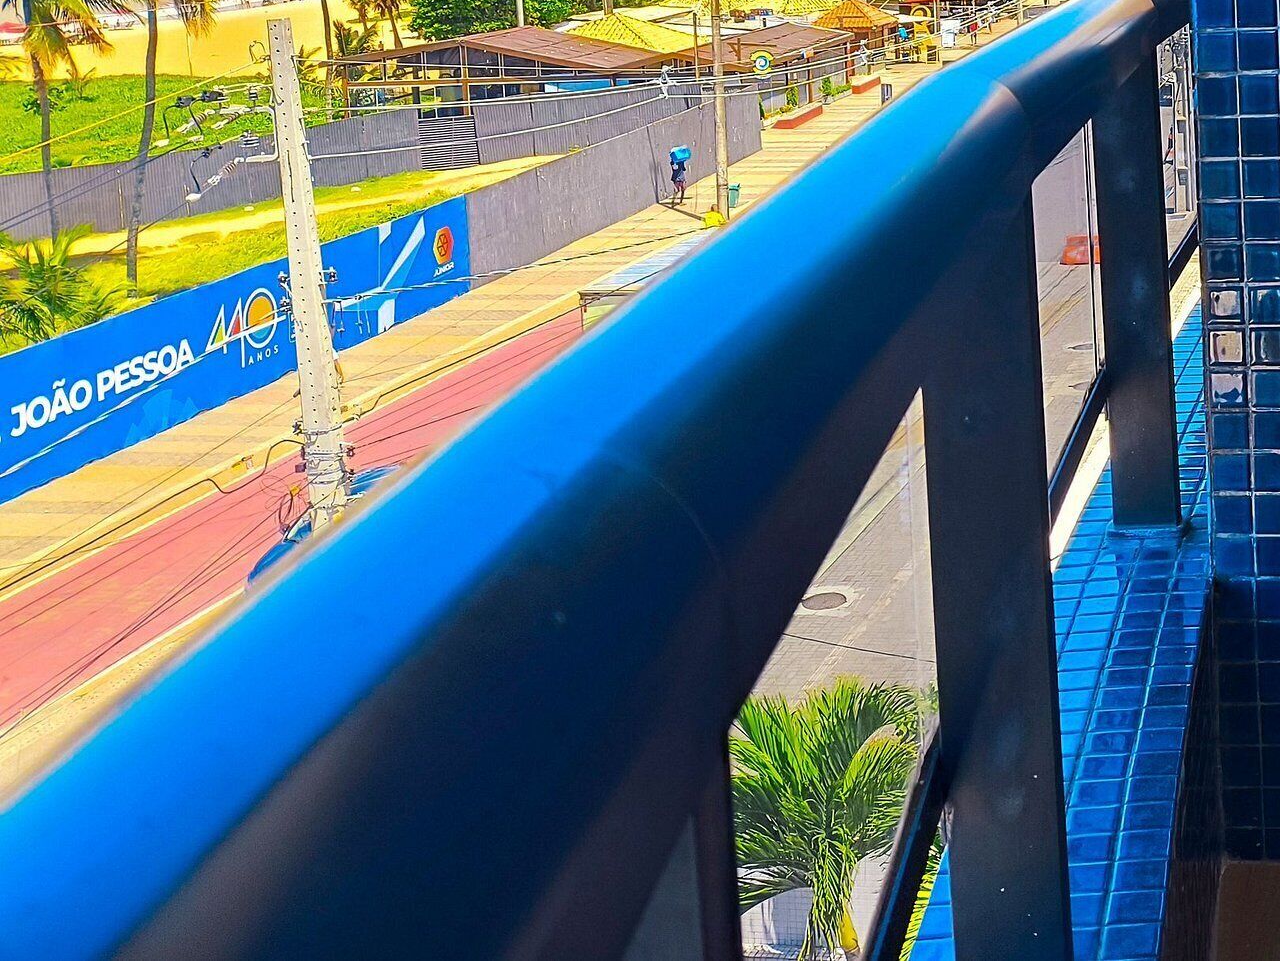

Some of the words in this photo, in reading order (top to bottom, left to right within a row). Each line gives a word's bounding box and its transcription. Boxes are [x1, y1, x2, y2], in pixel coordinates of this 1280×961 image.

[248, 344, 279, 366] ANOS
[10, 377, 93, 437] JOÃO
[96, 338, 195, 402] PESSOA
